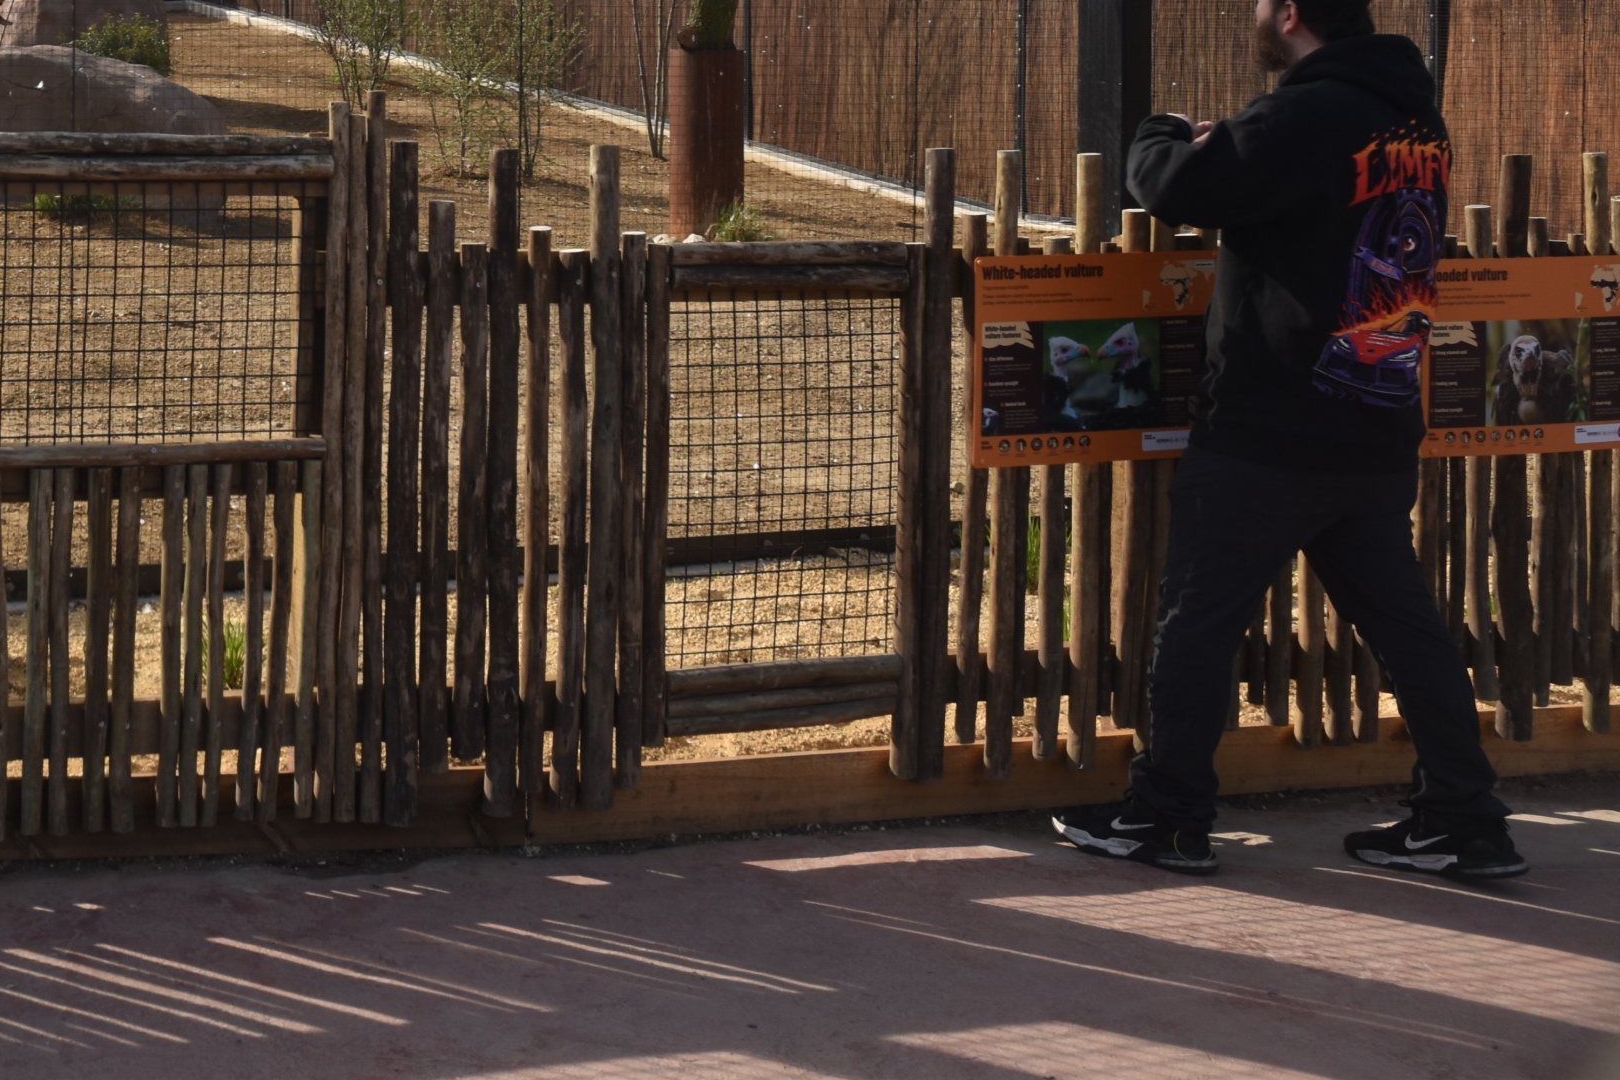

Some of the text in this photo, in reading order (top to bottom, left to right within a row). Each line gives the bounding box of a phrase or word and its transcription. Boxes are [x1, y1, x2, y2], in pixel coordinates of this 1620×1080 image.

[983, 264, 1103, 280] White-headed vulture
[1436, 269, 1508, 282] ooded vulture
